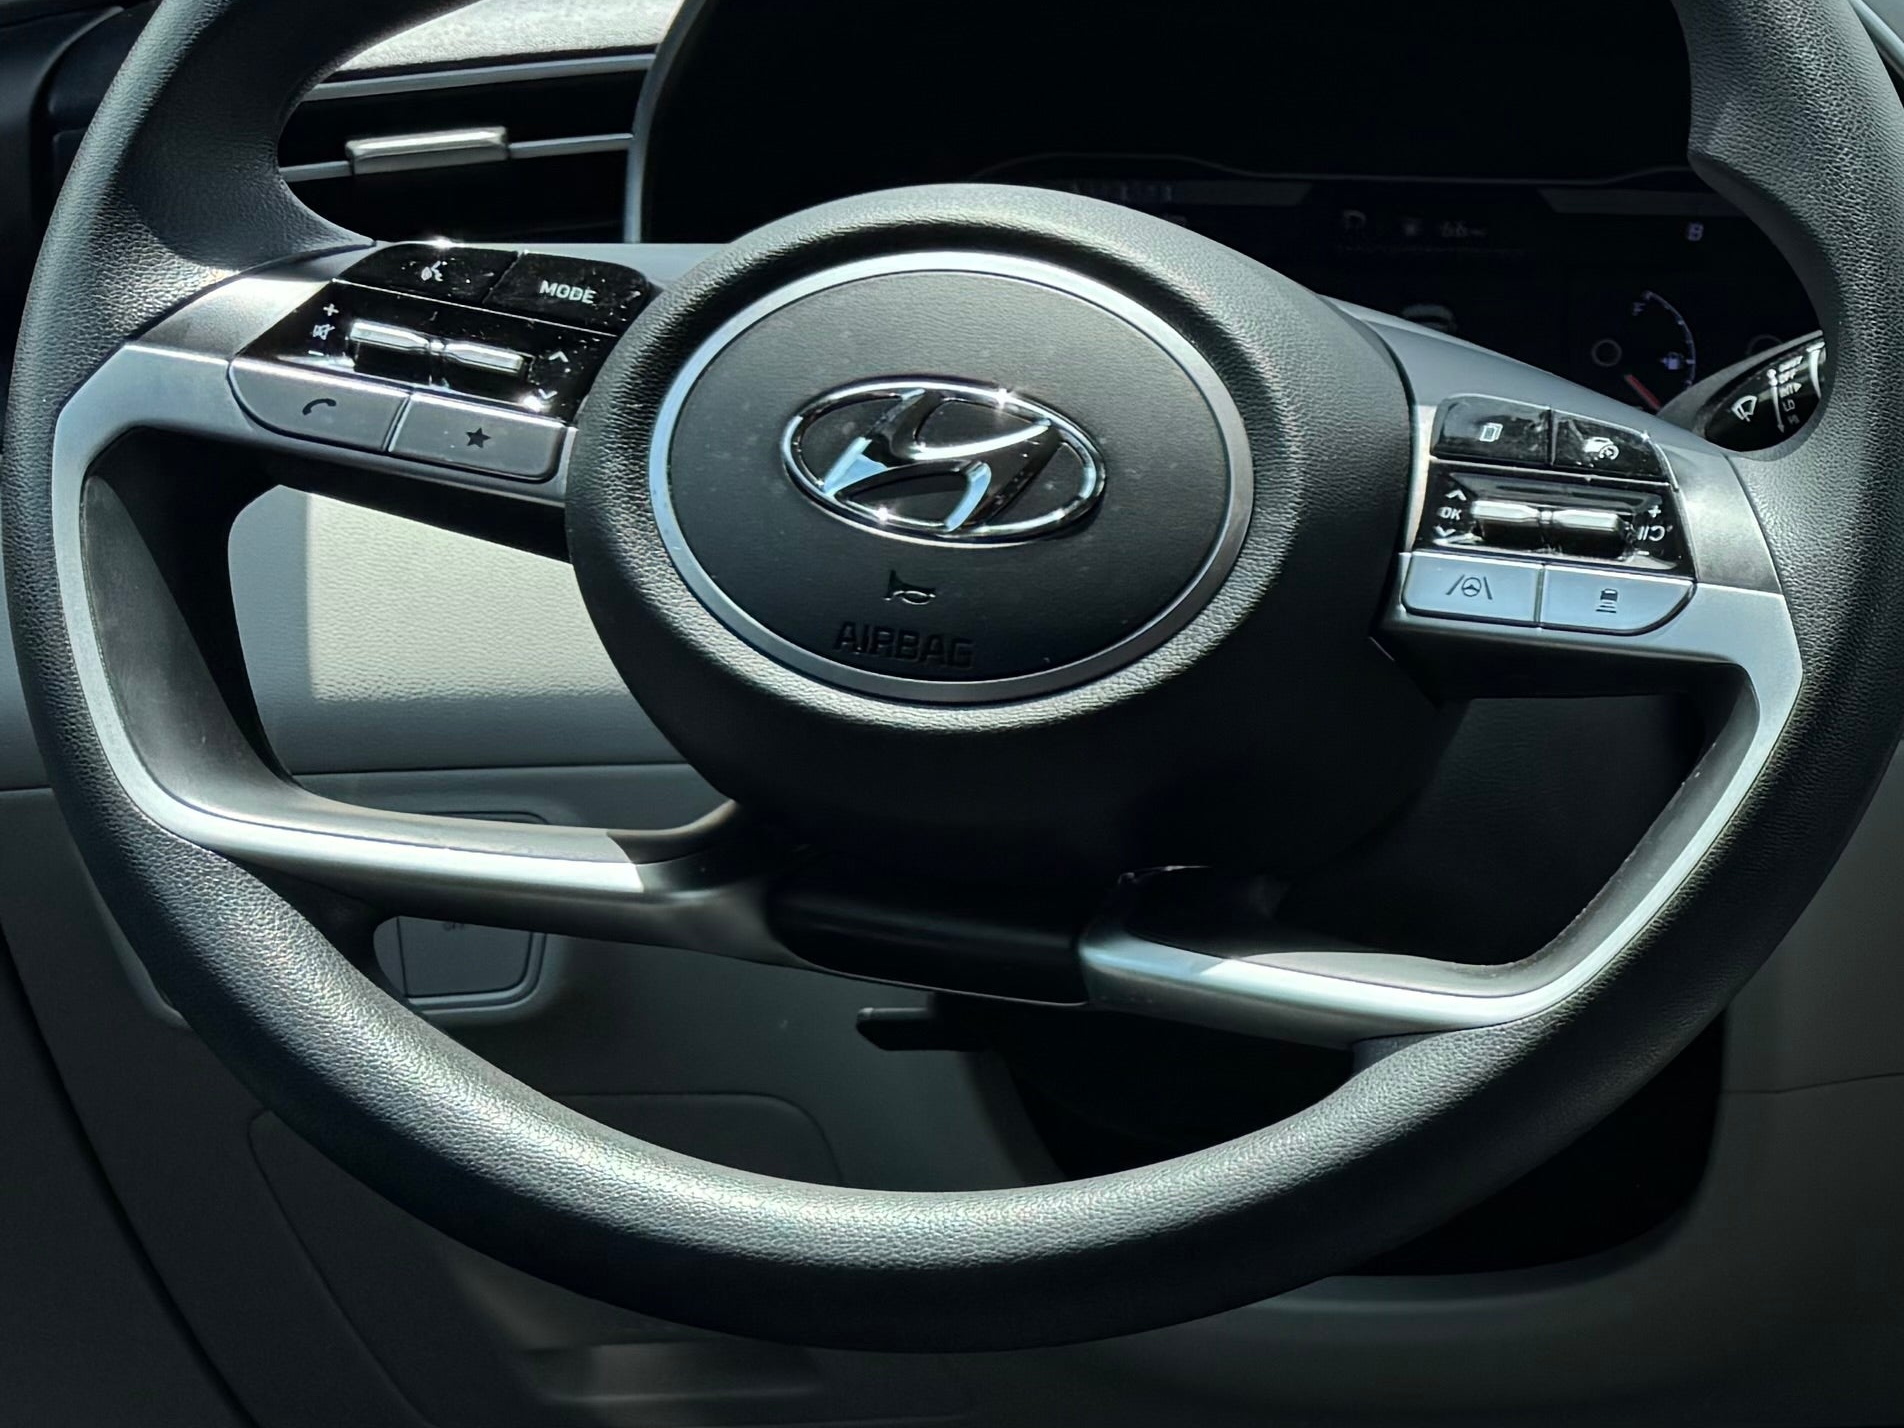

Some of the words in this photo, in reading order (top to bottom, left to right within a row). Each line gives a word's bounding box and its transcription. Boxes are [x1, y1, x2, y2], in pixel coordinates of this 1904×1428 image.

[539, 279, 597, 305] MODE
[1440, 507, 1462, 521] OK
[832, 620, 976, 670] AIRBAG
